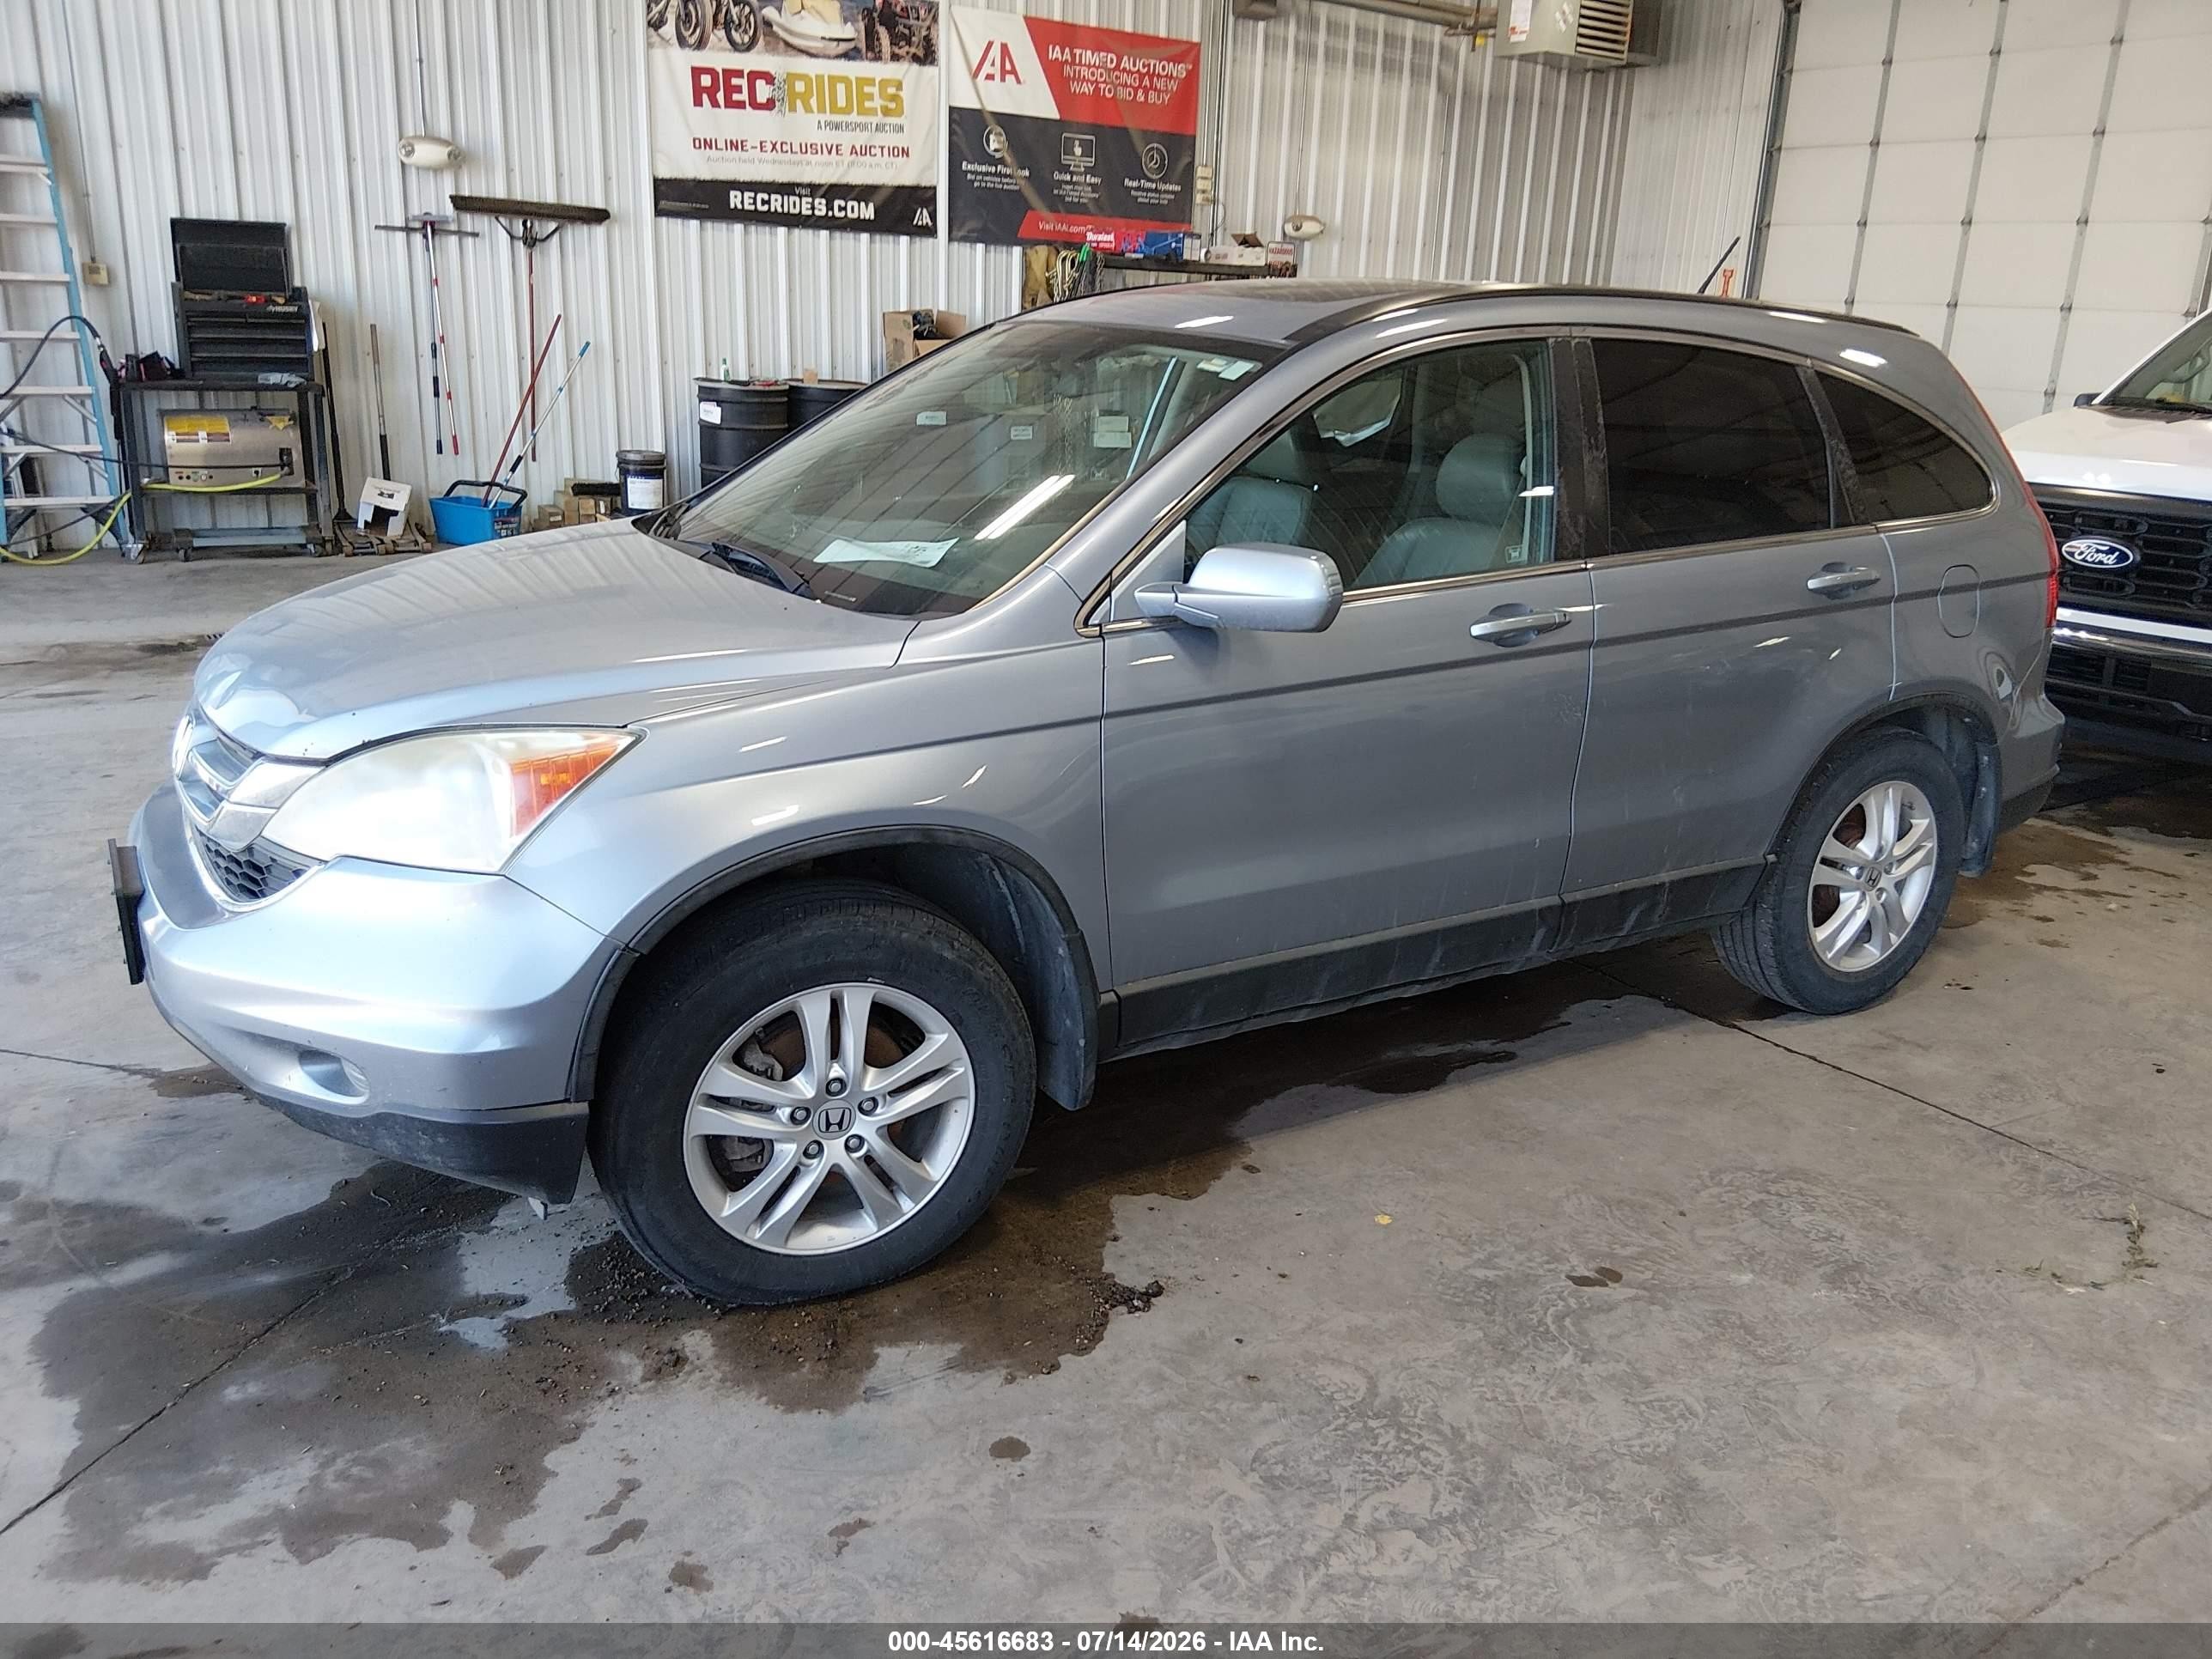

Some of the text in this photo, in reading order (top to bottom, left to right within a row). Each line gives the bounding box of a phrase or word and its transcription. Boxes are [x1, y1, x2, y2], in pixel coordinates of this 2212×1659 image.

[1073, 48, 1116, 69] TIMED
[1063, 64, 1178, 92] INTRODUCING A NEW
[1070, 81, 1171, 104] WAY TO BID & BUY
[817, 119, 904, 134] A POWERSPORT AUCTION
[692, 137, 910, 158] ONLINE-EXCLUSIVE AUCTION
[707, 155, 737, 165] Auction
[962, 161, 996, 173] Exclusive
[1016, 167, 1030, 178] ook
[1054, 171, 1102, 186] Quick and Easy
[1124, 178, 1182, 192] Real-Time Updates
[795, 187, 811, 196] Visit
[730, 191, 875, 220] RECRIDES.COM
[1038, 222, 1054, 231] Visit
[2074, 543, 2119, 564] Ford
